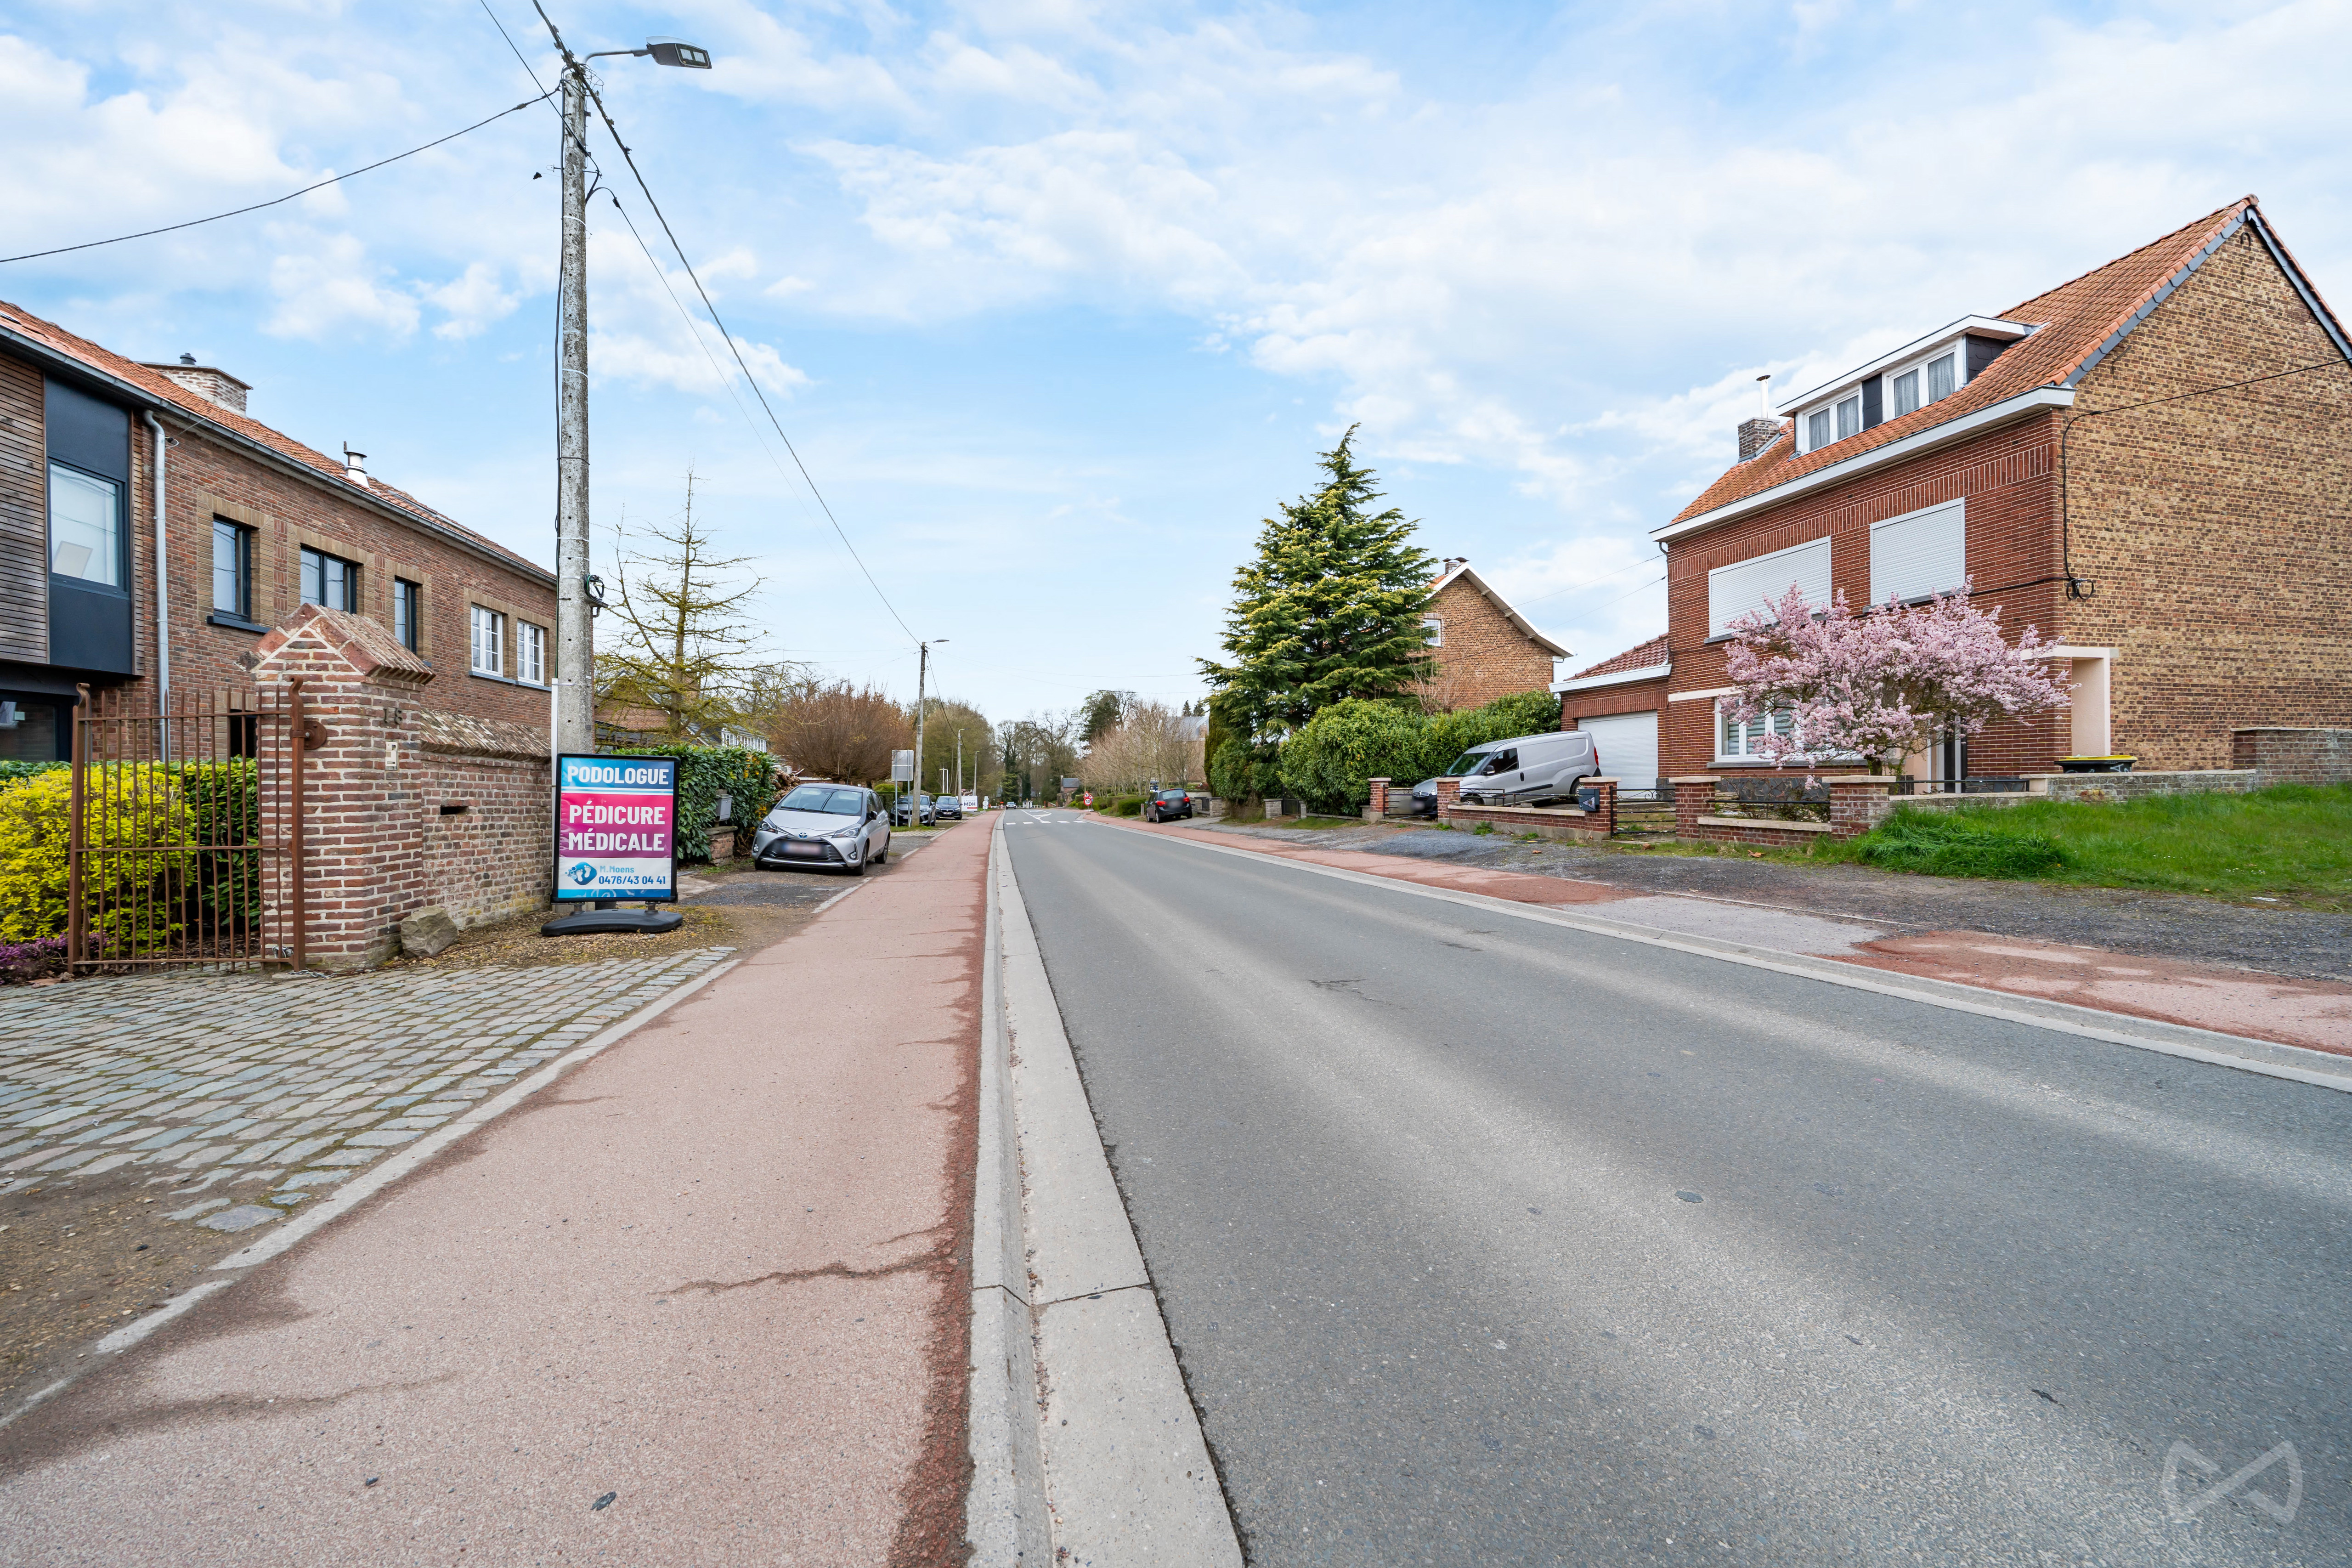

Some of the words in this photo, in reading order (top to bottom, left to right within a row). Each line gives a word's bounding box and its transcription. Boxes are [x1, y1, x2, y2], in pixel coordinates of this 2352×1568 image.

[384, 707, 403, 725] 18
[567, 766, 669, 785] PODOLOGUE
[569, 801, 665, 825] PÉDICURE
[568, 828, 665, 851] MÉDICALE
[599, 876, 639, 884] 0476/43
[642, 876, 654, 884] 04
[656, 876, 666, 884] 41
